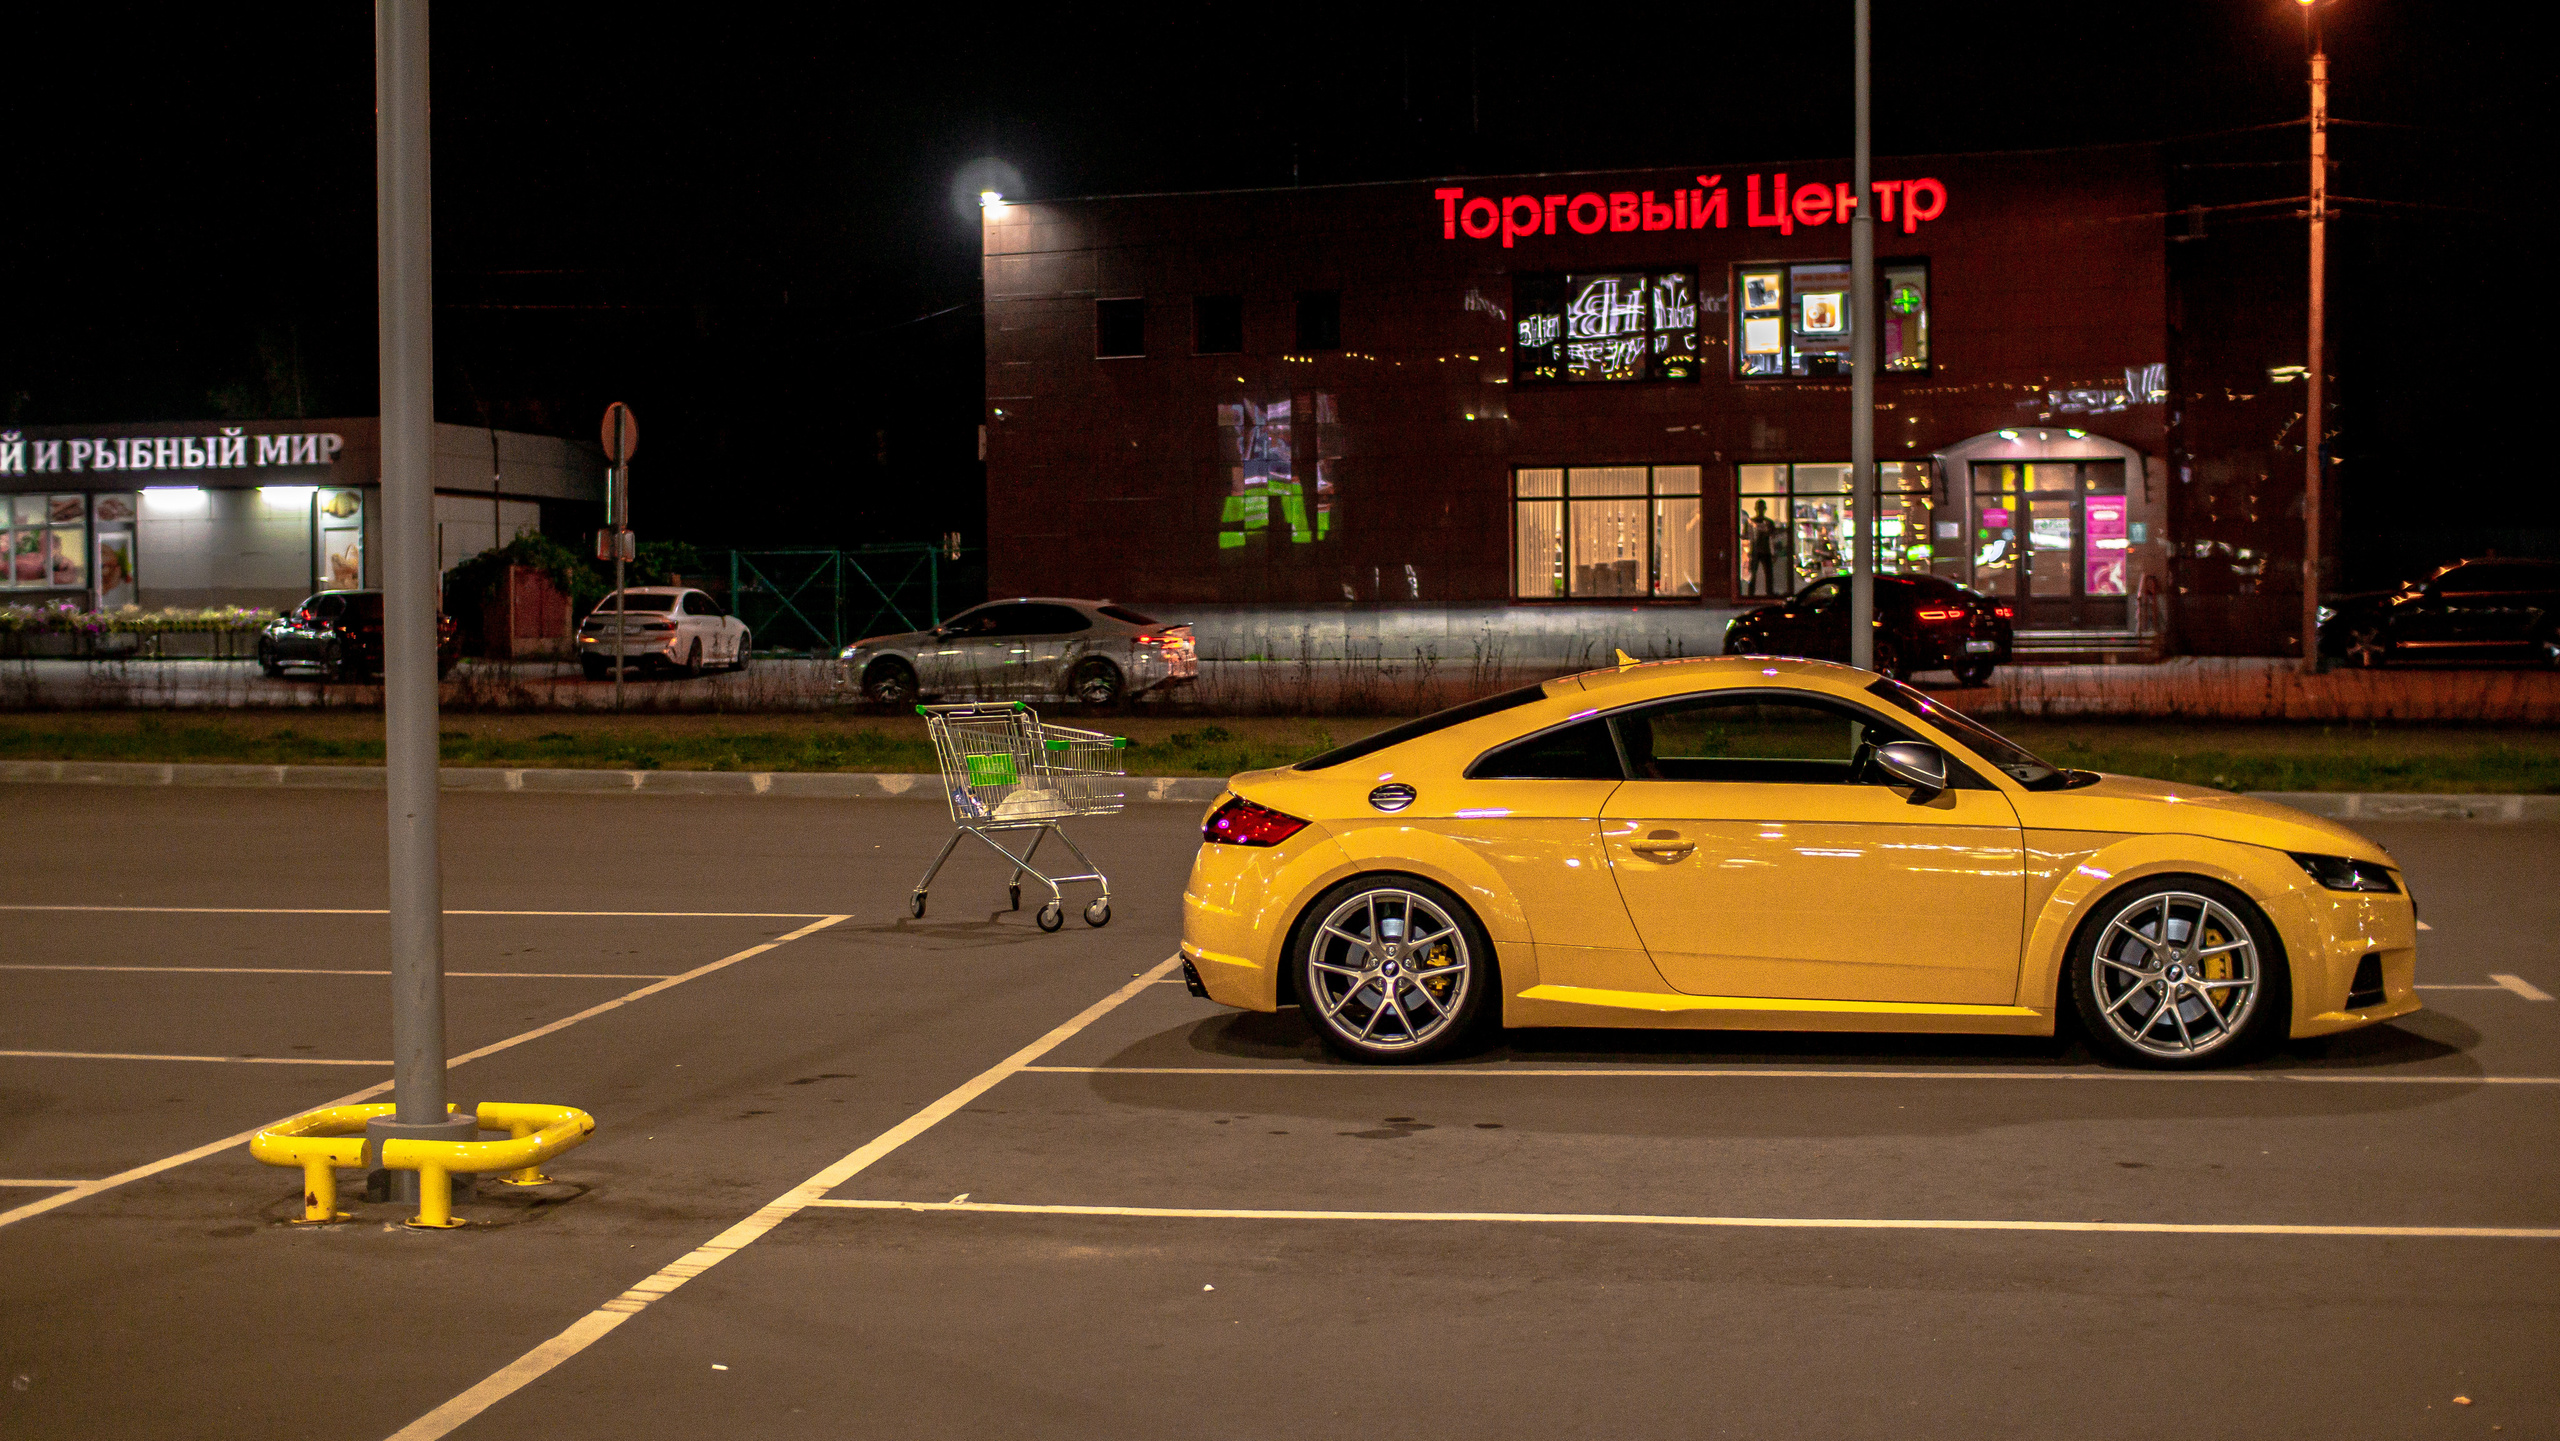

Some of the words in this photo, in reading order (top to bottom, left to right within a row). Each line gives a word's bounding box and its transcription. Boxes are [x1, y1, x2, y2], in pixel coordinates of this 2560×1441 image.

[1434, 174, 1729, 249] Торговый
[32, 439, 62, 472] И
[67, 427, 247, 471] РЫБНЫЙ
[256, 433, 344, 466] МИР
